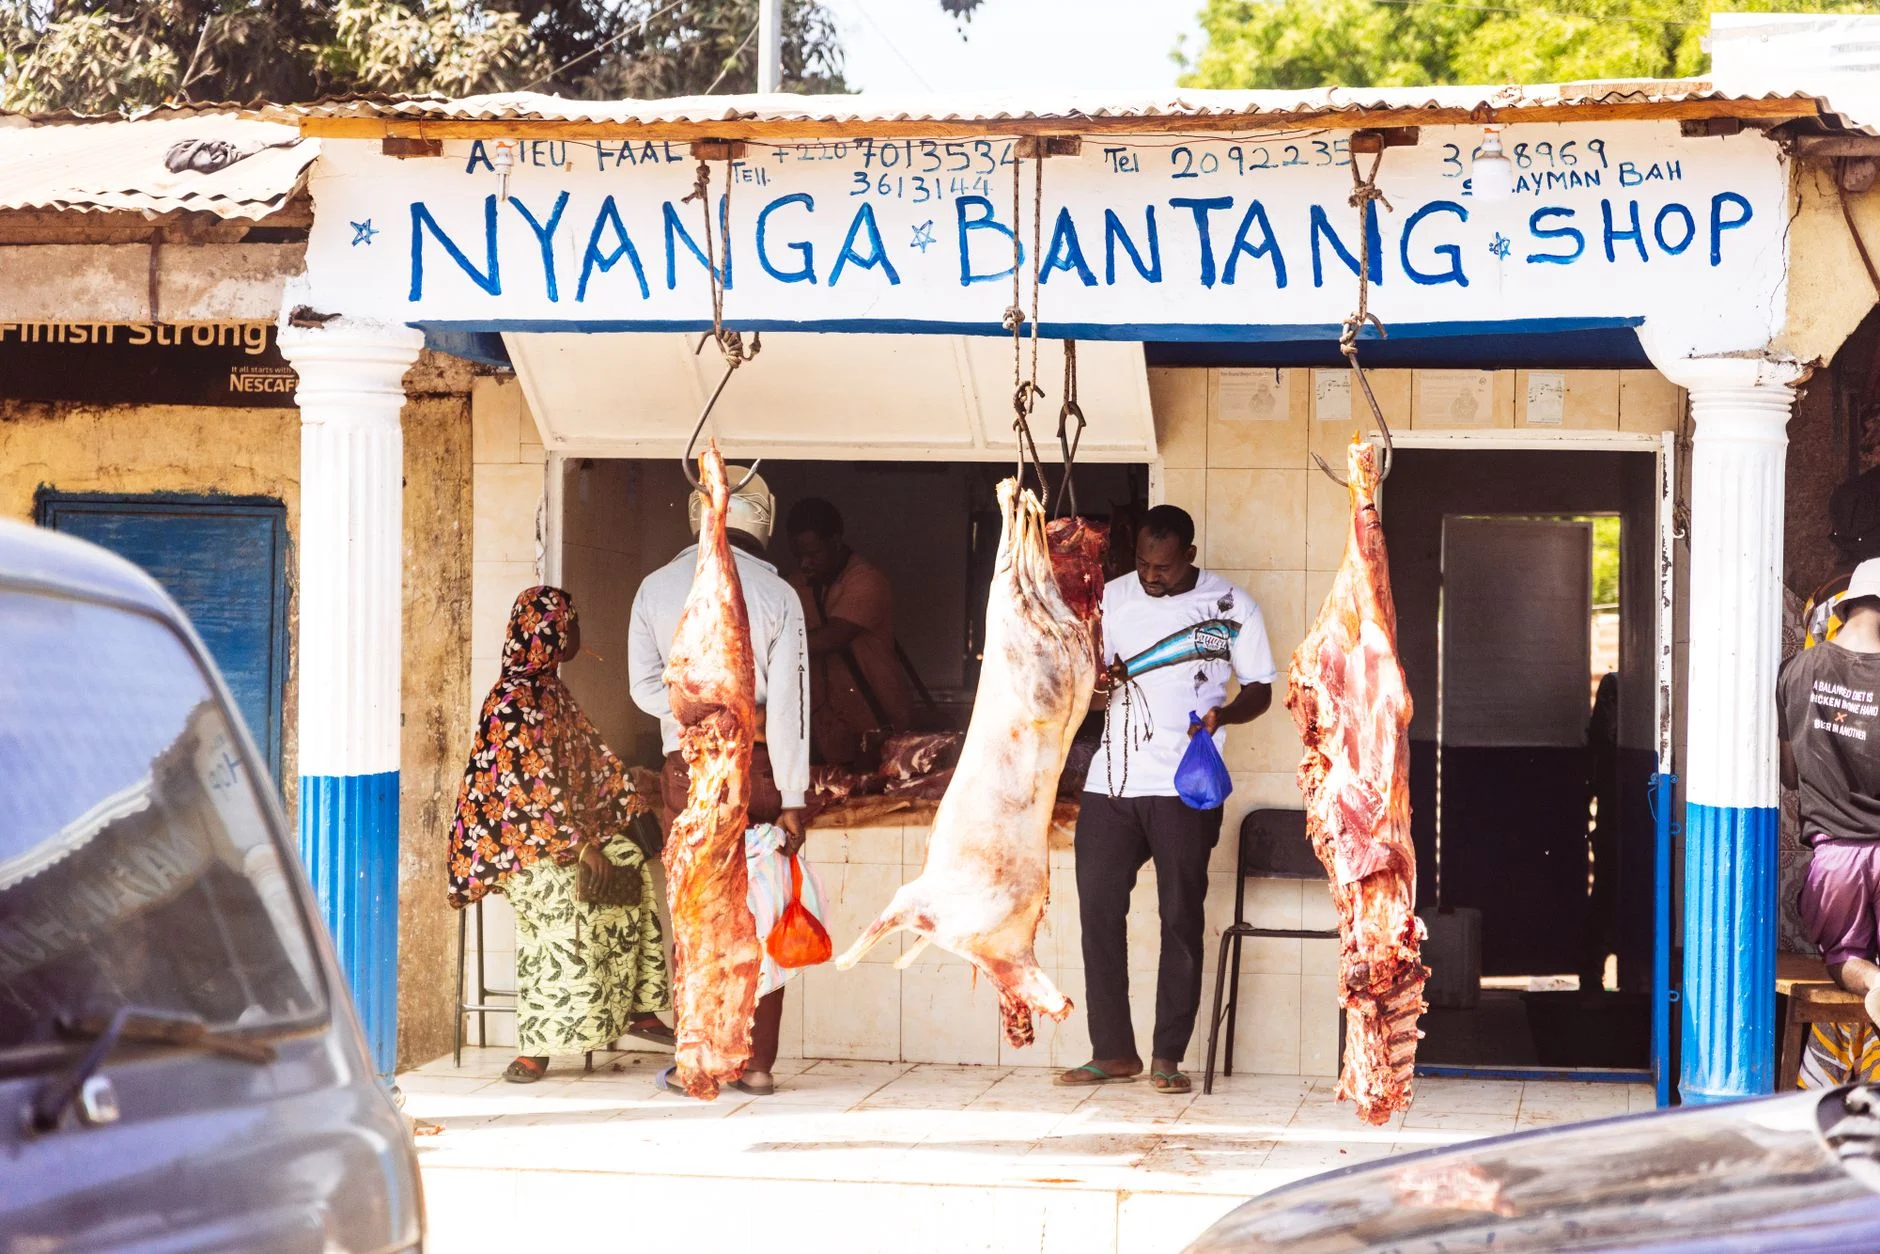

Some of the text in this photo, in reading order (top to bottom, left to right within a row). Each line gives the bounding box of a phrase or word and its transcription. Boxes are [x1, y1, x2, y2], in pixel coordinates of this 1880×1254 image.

[466, 140, 567, 174] AIEU
[1104, 139, 1352, 178] Tel 2092235
[1442, 139, 1609, 178] 38969
[1619, 160, 1682, 187] BAH
[850, 171, 993, 203] 3613144
[408, 190, 1754, 303] NYANGA BANTANG SHOP
[128, 321, 267, 355] Strong
